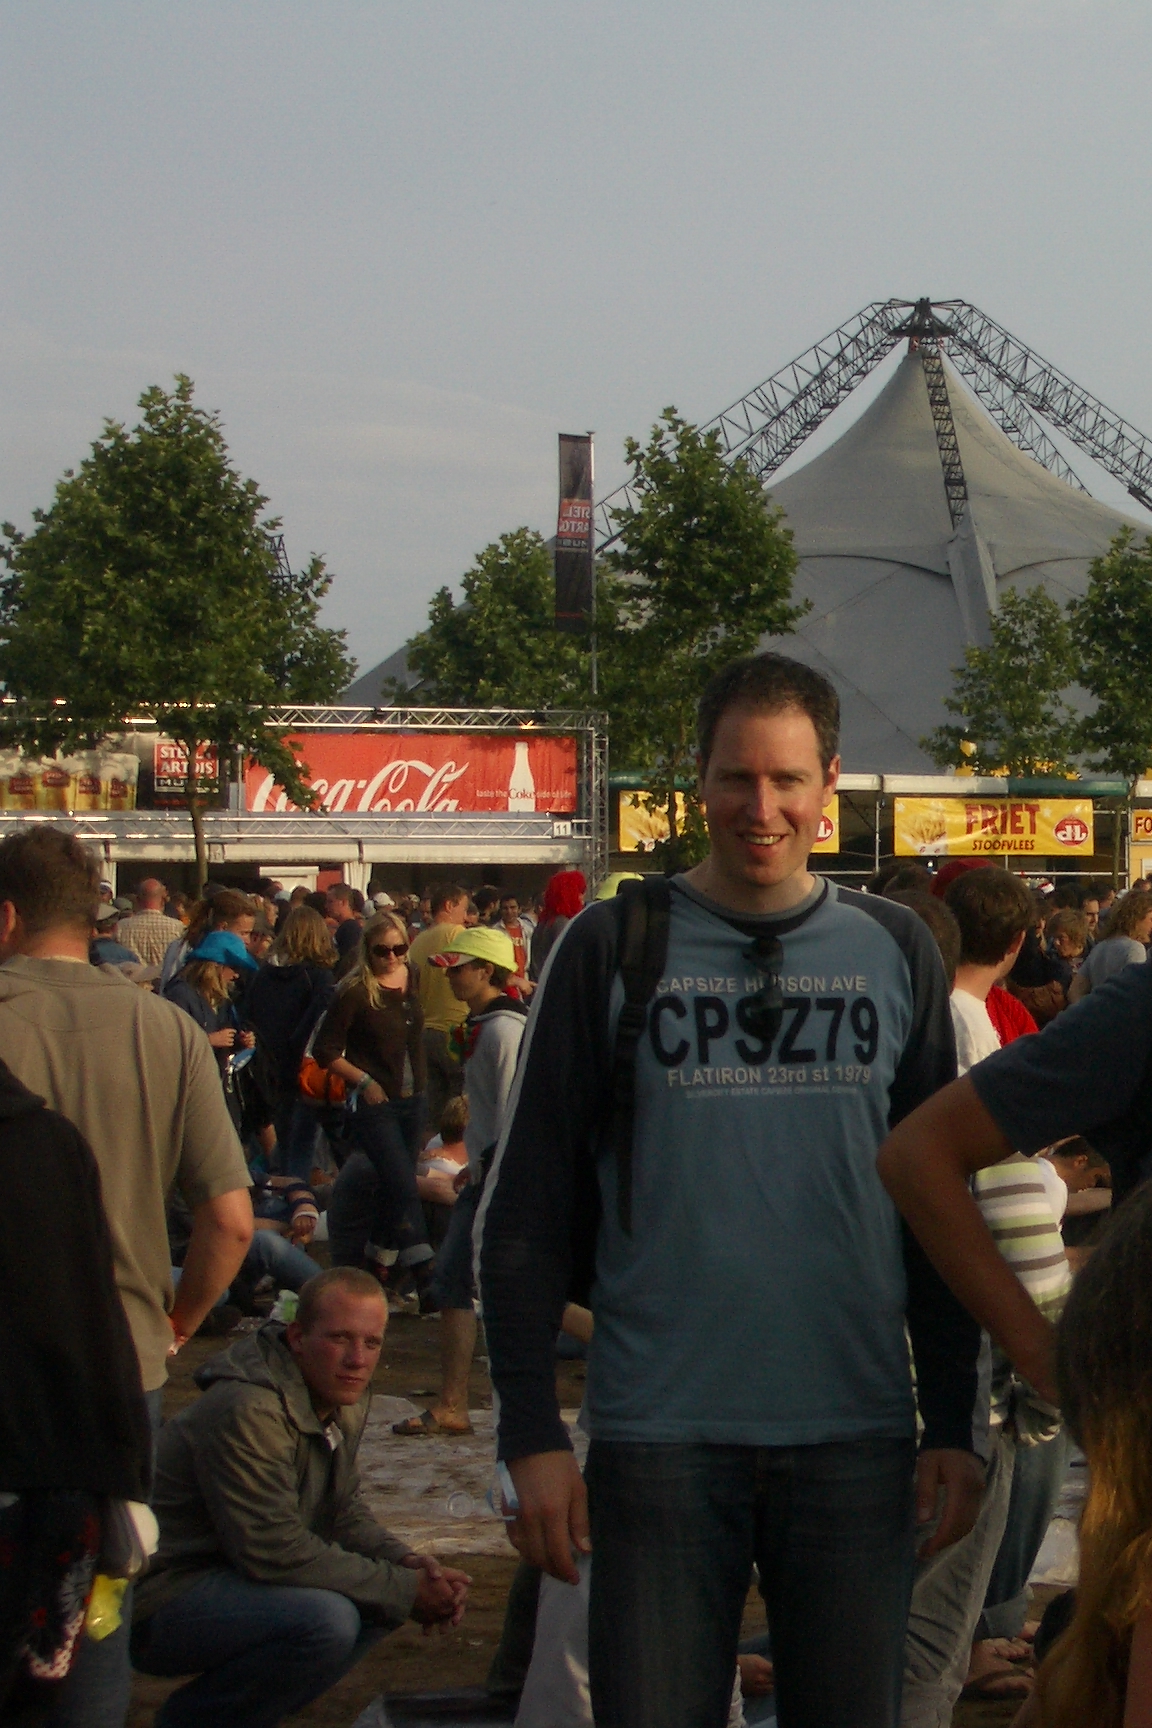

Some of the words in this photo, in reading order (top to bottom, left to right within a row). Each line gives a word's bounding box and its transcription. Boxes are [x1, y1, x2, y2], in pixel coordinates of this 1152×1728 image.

[160, 761, 214, 774] ARTIS
[251, 760, 470, 812] Ca-Cola
[965, 803, 1041, 835] FRIET
[556, 824, 568, 836] 11
[972, 839, 1035, 851] STOOFVLEES
[656, 976, 738, 994] CAPSIZE
[744, 975, 826, 993] HSON
[831, 975, 868, 992] AVE
[650, 996, 880, 1067] CPSZ79
[667, 1066, 763, 1087] FLATIRON
[768, 1066, 808, 1084] 23rd
[812, 1067, 829, 1083] st
[835, 1066, 872, 1085] 1979
